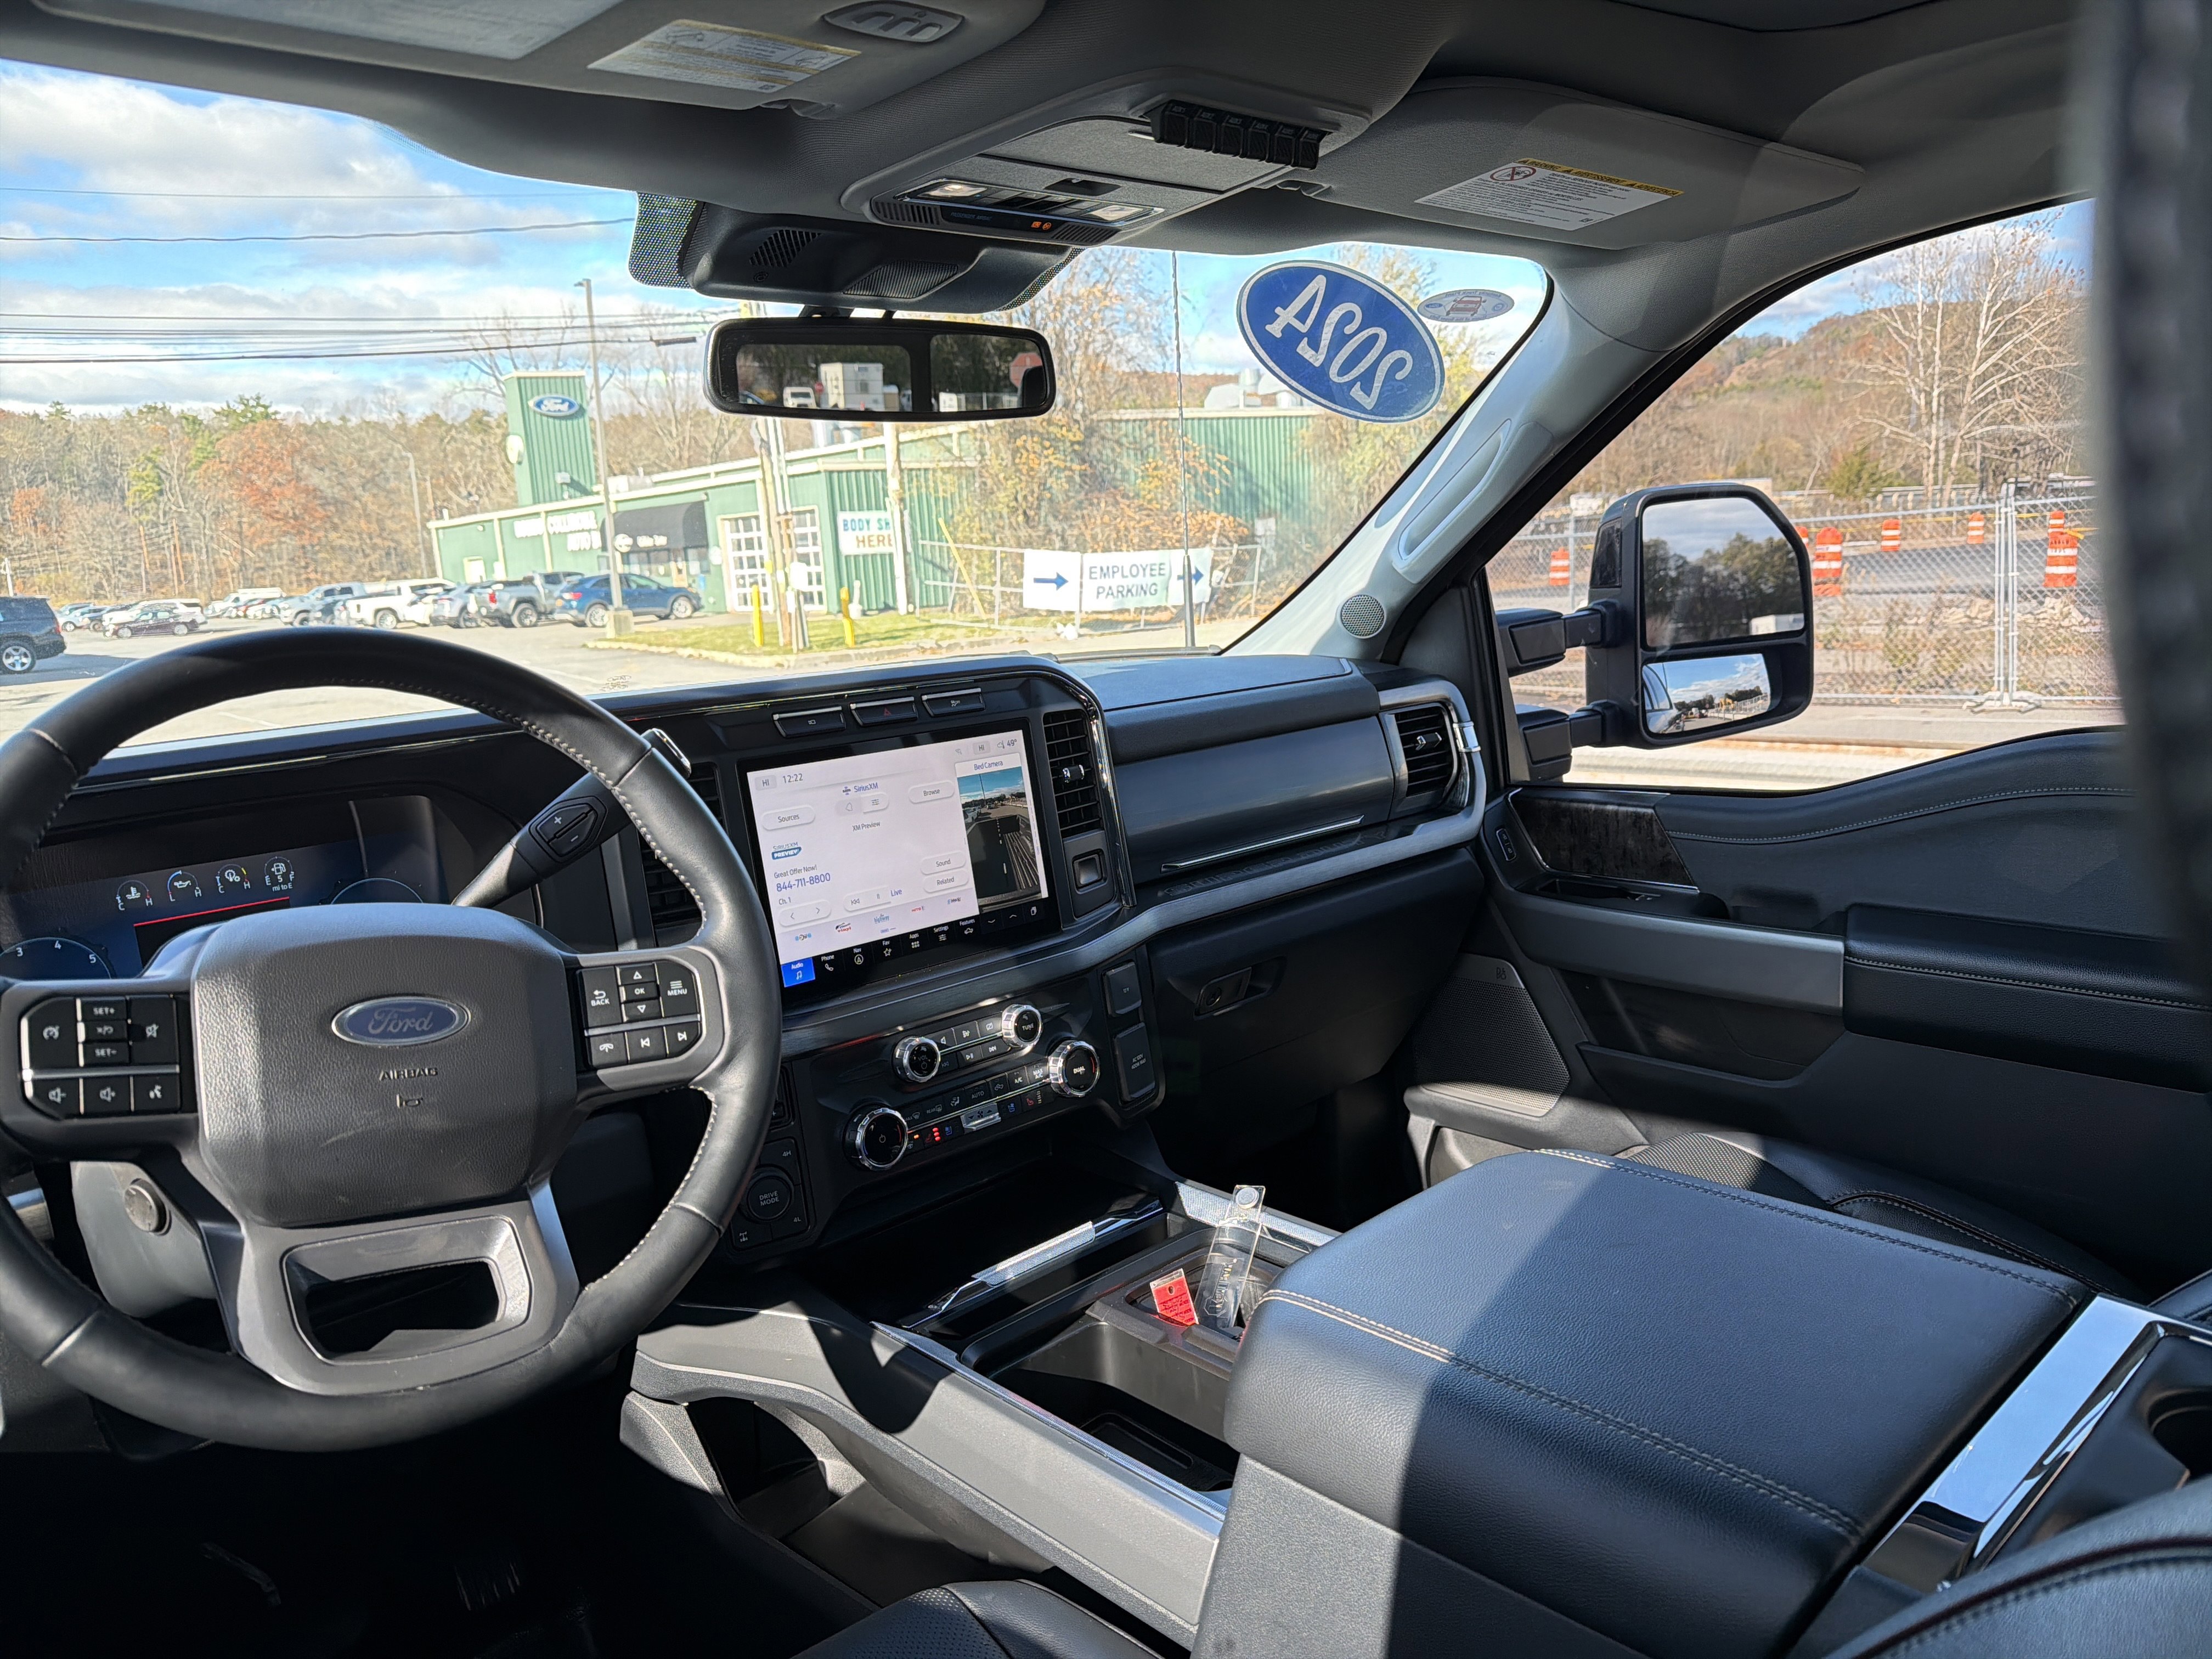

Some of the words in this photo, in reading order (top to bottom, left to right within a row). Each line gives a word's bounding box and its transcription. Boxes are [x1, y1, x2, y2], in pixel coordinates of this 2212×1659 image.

[540, 399, 569, 411] Ford
[843, 518, 870, 532] BODY
[1089, 562, 1166, 580] EMPLOYEE
[1096, 583, 1158, 600] PARKING
[974, 762, 984, 770] Bed
[985, 760, 1003, 769] Camera
[782, 773, 804, 783] 12:22
[854, 782, 878, 793] SiriusXM
[777, 814, 800, 823] Sources
[861, 821, 881, 830] Preview
[936, 858, 951, 867] Sound
[774, 870, 788, 878] Great
[803, 864, 817, 873] Now!
[265, 876, 272, 886] E
[289, 873, 295, 882] F
[776, 872, 831, 892] 844-711-8800
[936, 876, 955, 885] Related
[218, 885, 225, 894] C
[244, 881, 251, 889] H
[288, 881, 293, 889] E
[194, 889, 202, 898] H
[119, 902, 125, 911] C
[145, 898, 153, 906] H
[54, 940, 62, 950] 4
[16, 947, 23, 957] 3
[89, 954, 97, 963] 5
[591, 998, 610, 1007] BACK
[368, 1006, 433, 1035] Ford
[1022, 1023, 1034, 1031] TUNE
[379, 1067, 438, 1081] AIRBAG
[1073, 1065, 1086, 1074] DUAL
[971, 1091, 984, 1099] AUTO
[759, 1190, 778, 1201] DRIVE
[760, 1197, 780, 1206] MODE
